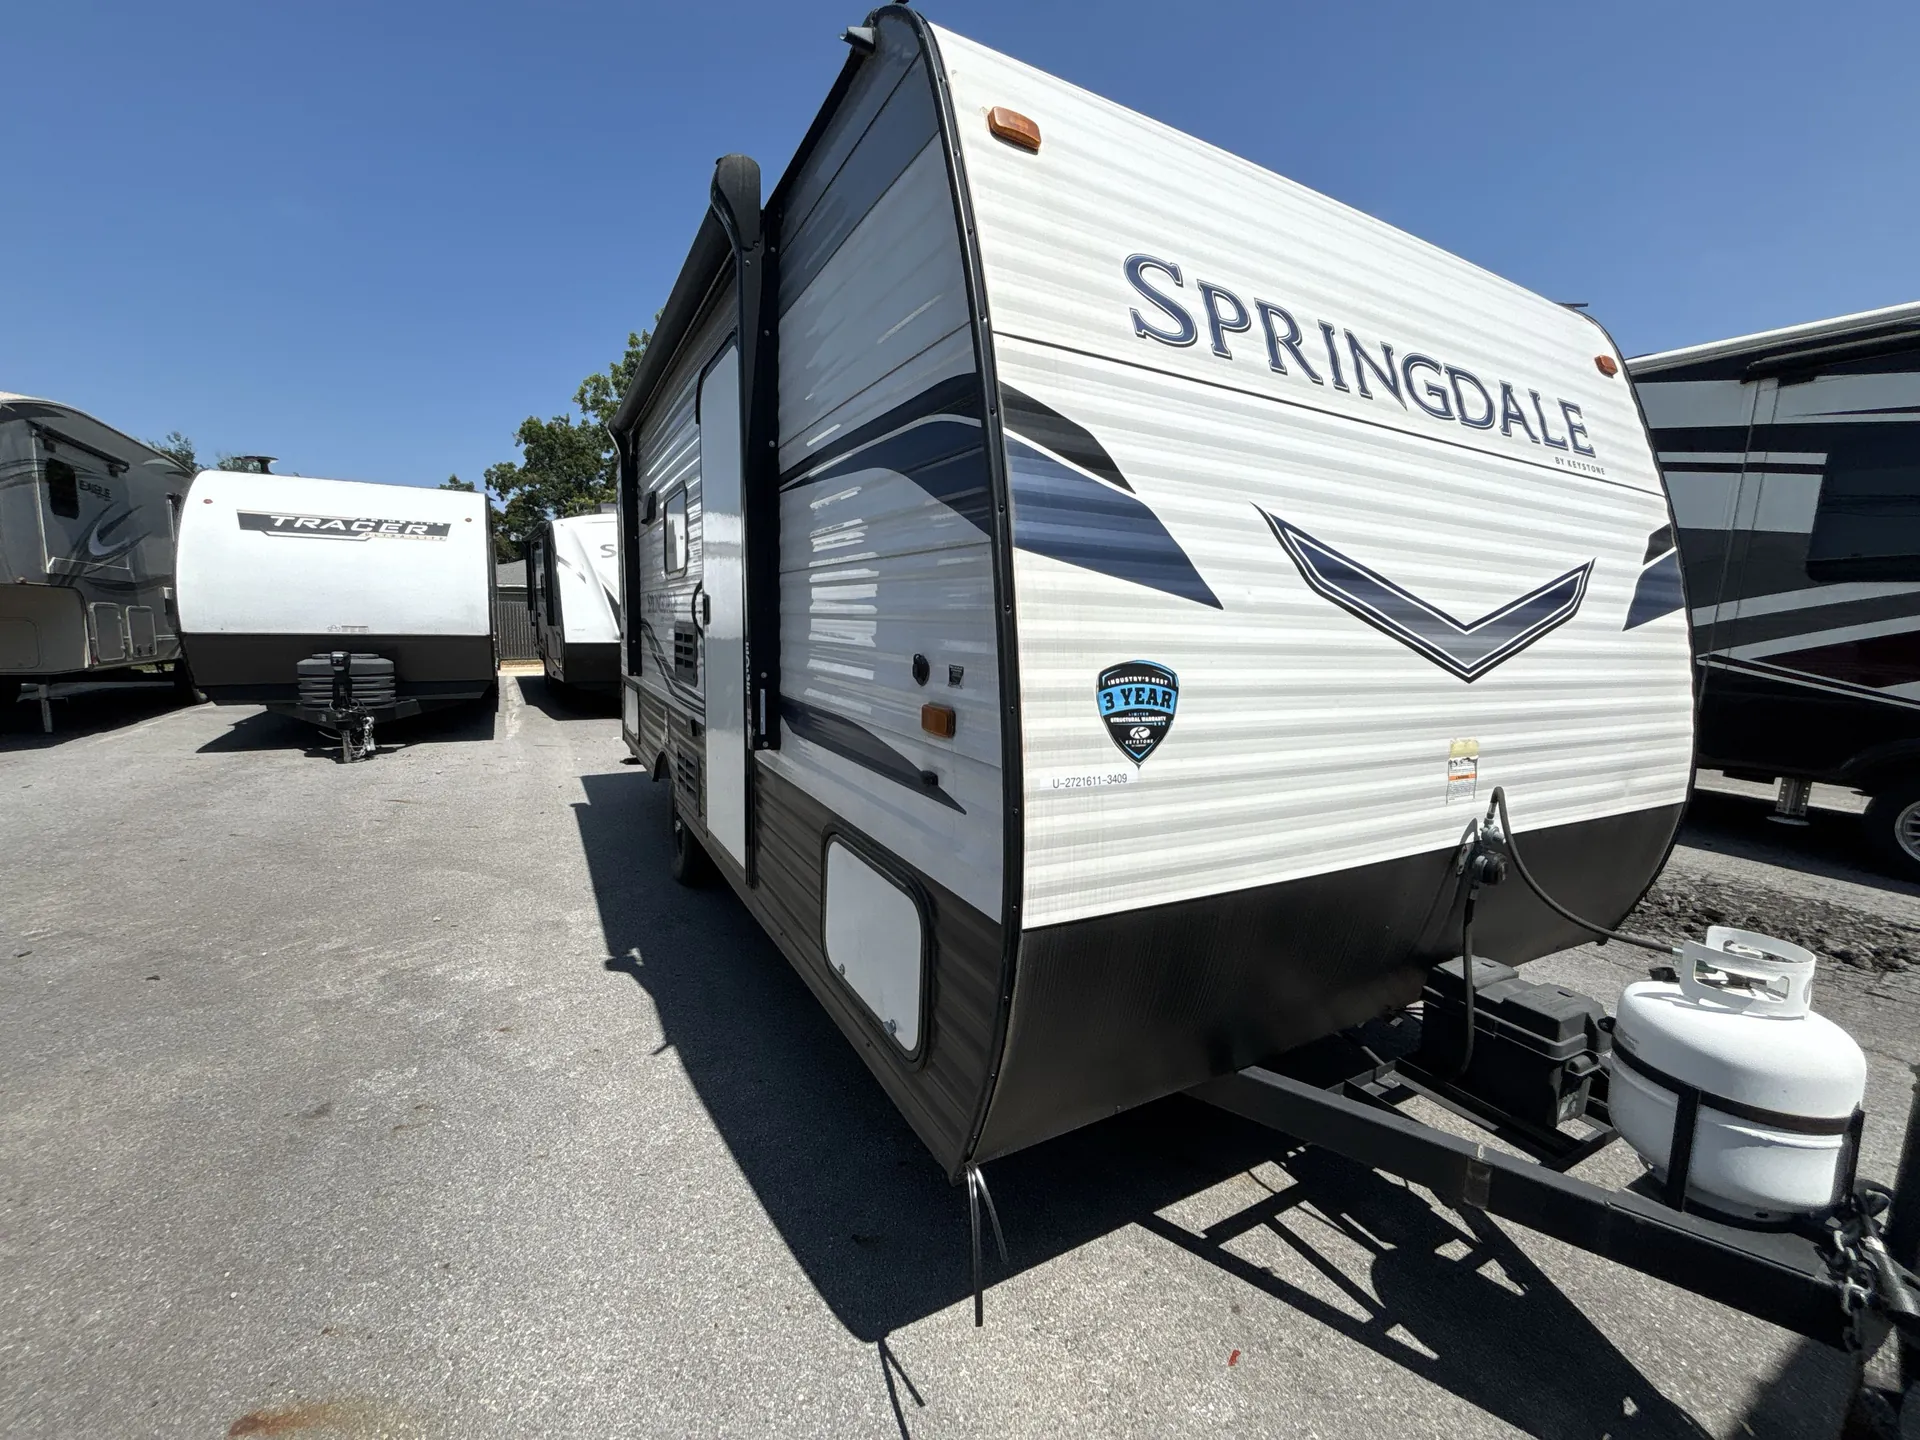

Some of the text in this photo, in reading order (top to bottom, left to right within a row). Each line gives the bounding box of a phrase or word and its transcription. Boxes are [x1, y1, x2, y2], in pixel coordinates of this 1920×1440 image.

[1123, 252, 1596, 459] SPRINGDALE
[1567, 460, 1606, 476] KEYSTONE
[270, 515, 429, 535] TRACER
[1103, 686, 1173, 711] 3 YEAR
[1052, 773, 1128, 789] U-2721611-3409
